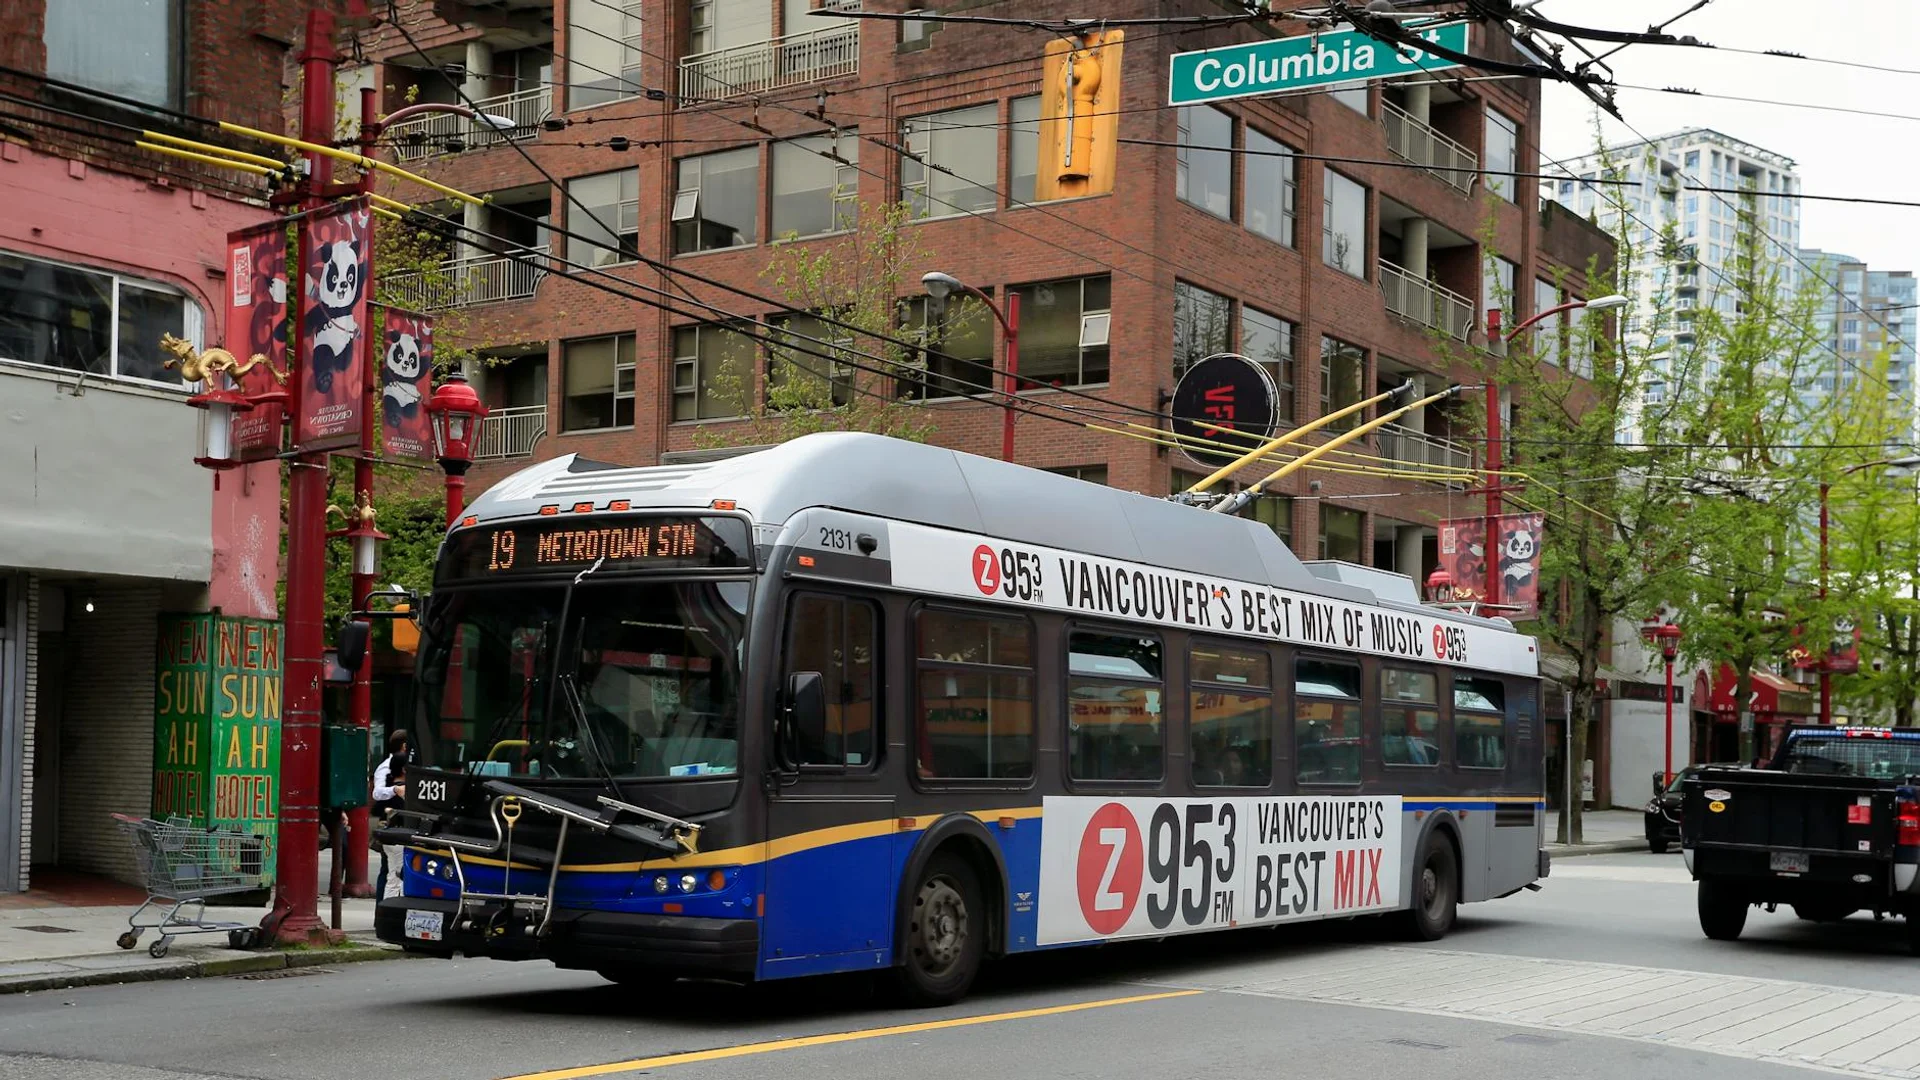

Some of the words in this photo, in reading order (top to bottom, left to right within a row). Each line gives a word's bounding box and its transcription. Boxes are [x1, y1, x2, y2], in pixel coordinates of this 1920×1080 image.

[1194, 39, 1375, 92] Columbia
[488, 530, 516, 570] 19
[537, 527, 650, 562] METROTOWN
[656, 524, 696, 557] STN
[819, 526, 851, 550] 2131
[1059, 557, 1234, 629] VANCOUVER'S
[1241, 588, 1293, 637] BEST
[1300, 600, 1337, 645] MIX
[1343, 607, 1364, 648] OF
[1370, 612, 1423, 657] MUSIC
[159, 620, 209, 666] NEW
[218, 620, 280, 671] NEW
[159, 670, 208, 715] SUN
[220, 673, 280, 719] SUN
[166, 720, 199, 766] AH
[226, 724, 270, 769] AH
[457, 742, 465, 762] 7
[154, 769, 206, 819] HOTEL
[215, 774, 276, 820] HOTEL
[418, 779, 447, 801] 2131
[1257, 800, 1384, 844] VANCOUVER'S
[1212, 889, 1235, 923] FM
[1254, 850, 1326, 919] BEST
[1333, 848, 1383, 910] MIX
